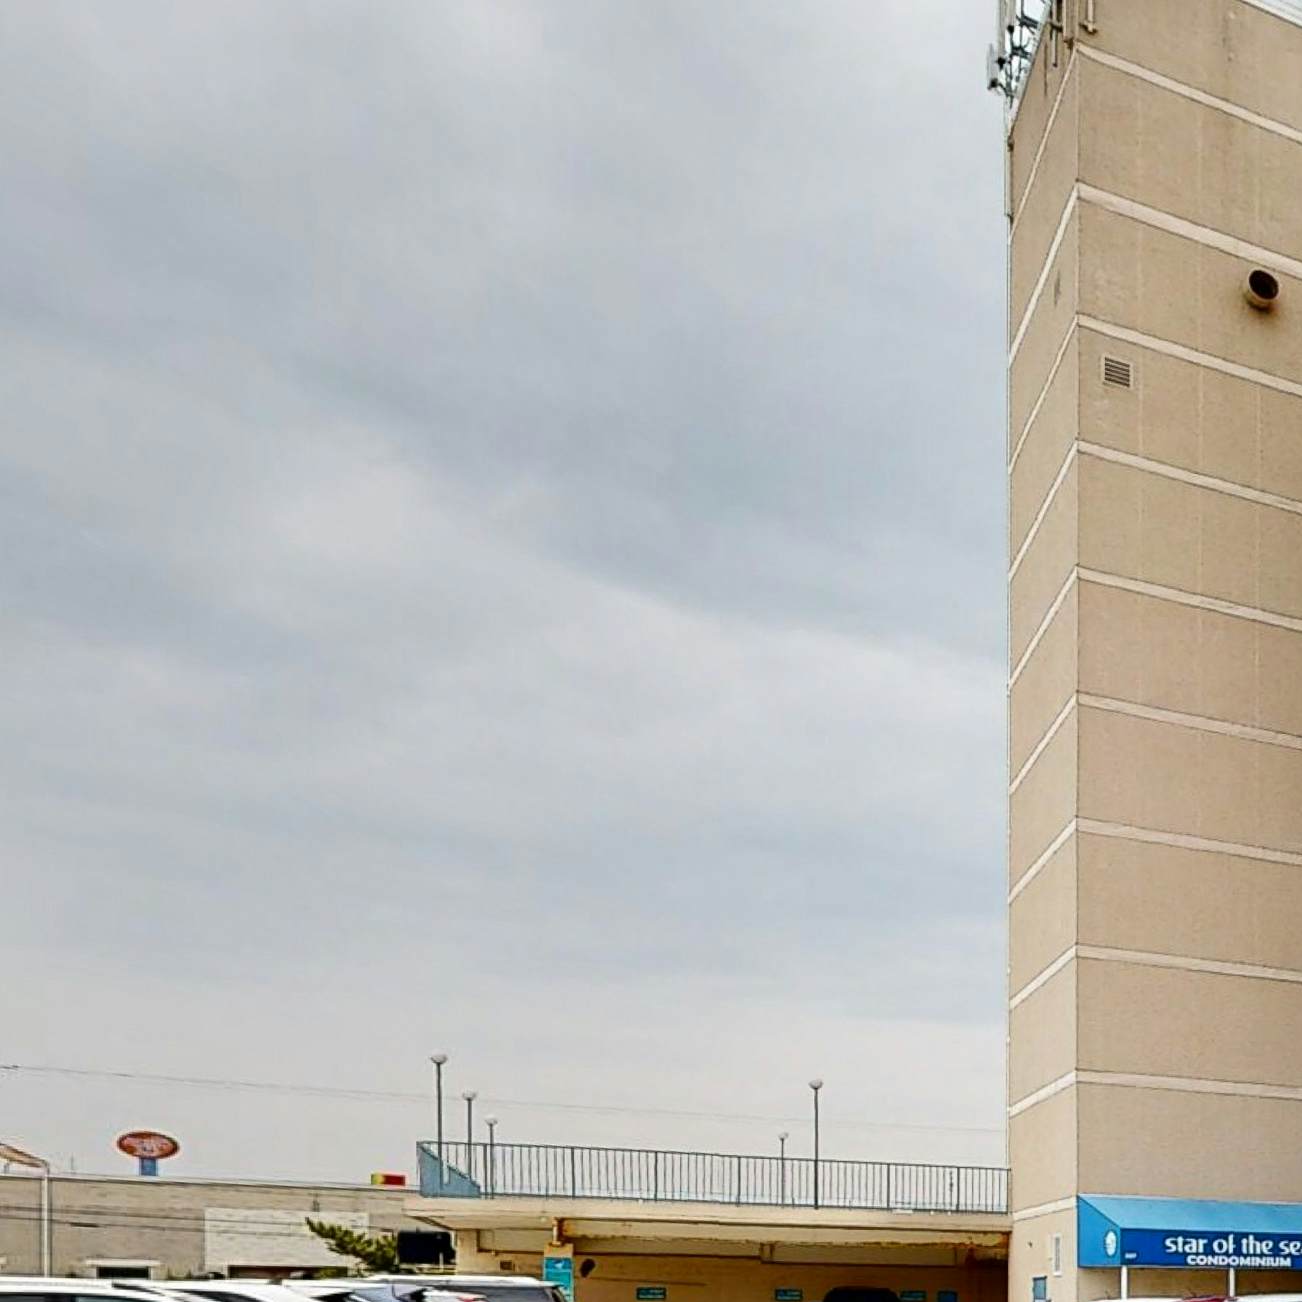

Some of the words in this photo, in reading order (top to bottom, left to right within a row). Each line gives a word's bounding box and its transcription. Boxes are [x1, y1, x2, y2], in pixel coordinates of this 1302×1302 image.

[1165, 1235, 1207, 1253] star
[1212, 1234, 1235, 1254] of
[1241, 1235, 1273, 1254] the
[1187, 1254, 1291, 1266] CONDOMINIUM
